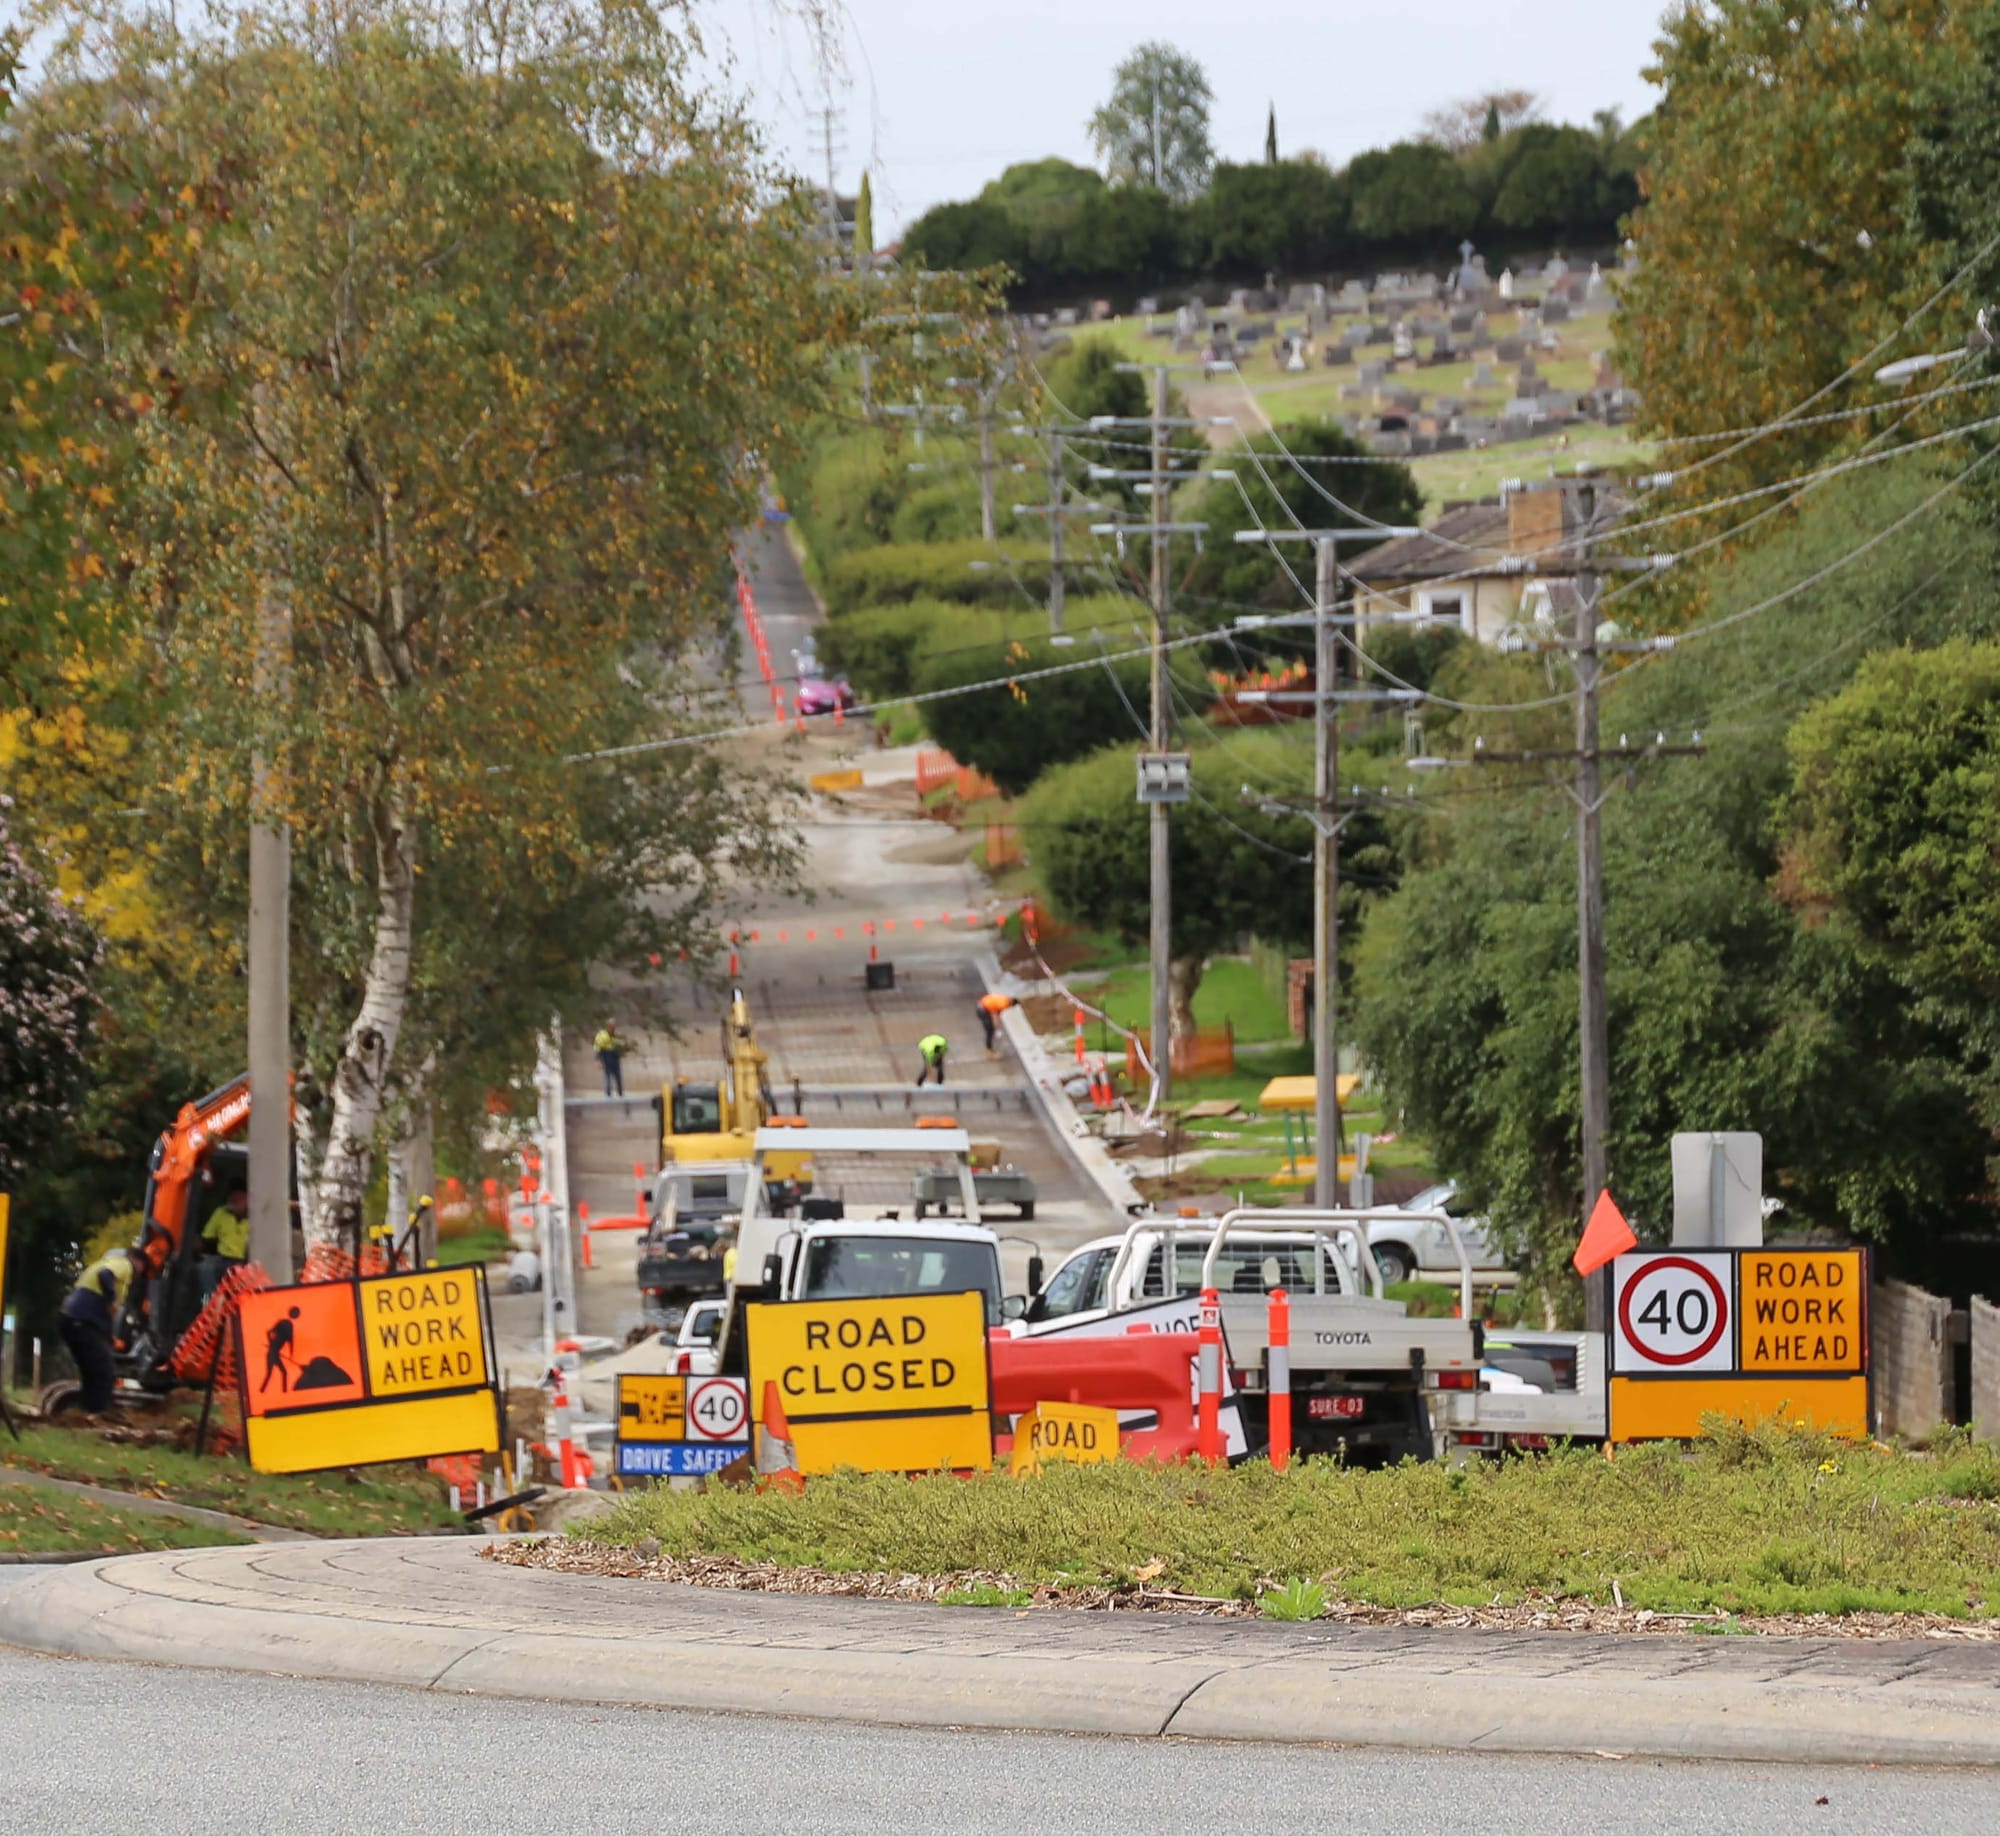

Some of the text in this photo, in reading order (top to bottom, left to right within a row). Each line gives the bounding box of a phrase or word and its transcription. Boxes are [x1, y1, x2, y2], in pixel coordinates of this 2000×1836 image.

[1756, 1262, 1844, 1288] ROAD
[376, 1281, 461, 1314] ROAD
[1637, 1288, 1709, 1336] 40
[1755, 1298, 1846, 1325] WORK
[379, 1315, 467, 1349] WORK
[806, 1315, 926, 1351] ROAD
[1314, 1332, 1372, 1345] TOYOTA
[1754, 1335, 1849, 1361] AHEAD
[383, 1351, 473, 1385] AHEAD
[782, 1358, 956, 1396] CLOSED
[699, 1395, 739, 1422] 40
[1030, 1420, 1097, 1450] ROAD
[622, 1447, 673, 1471] DRIVE
